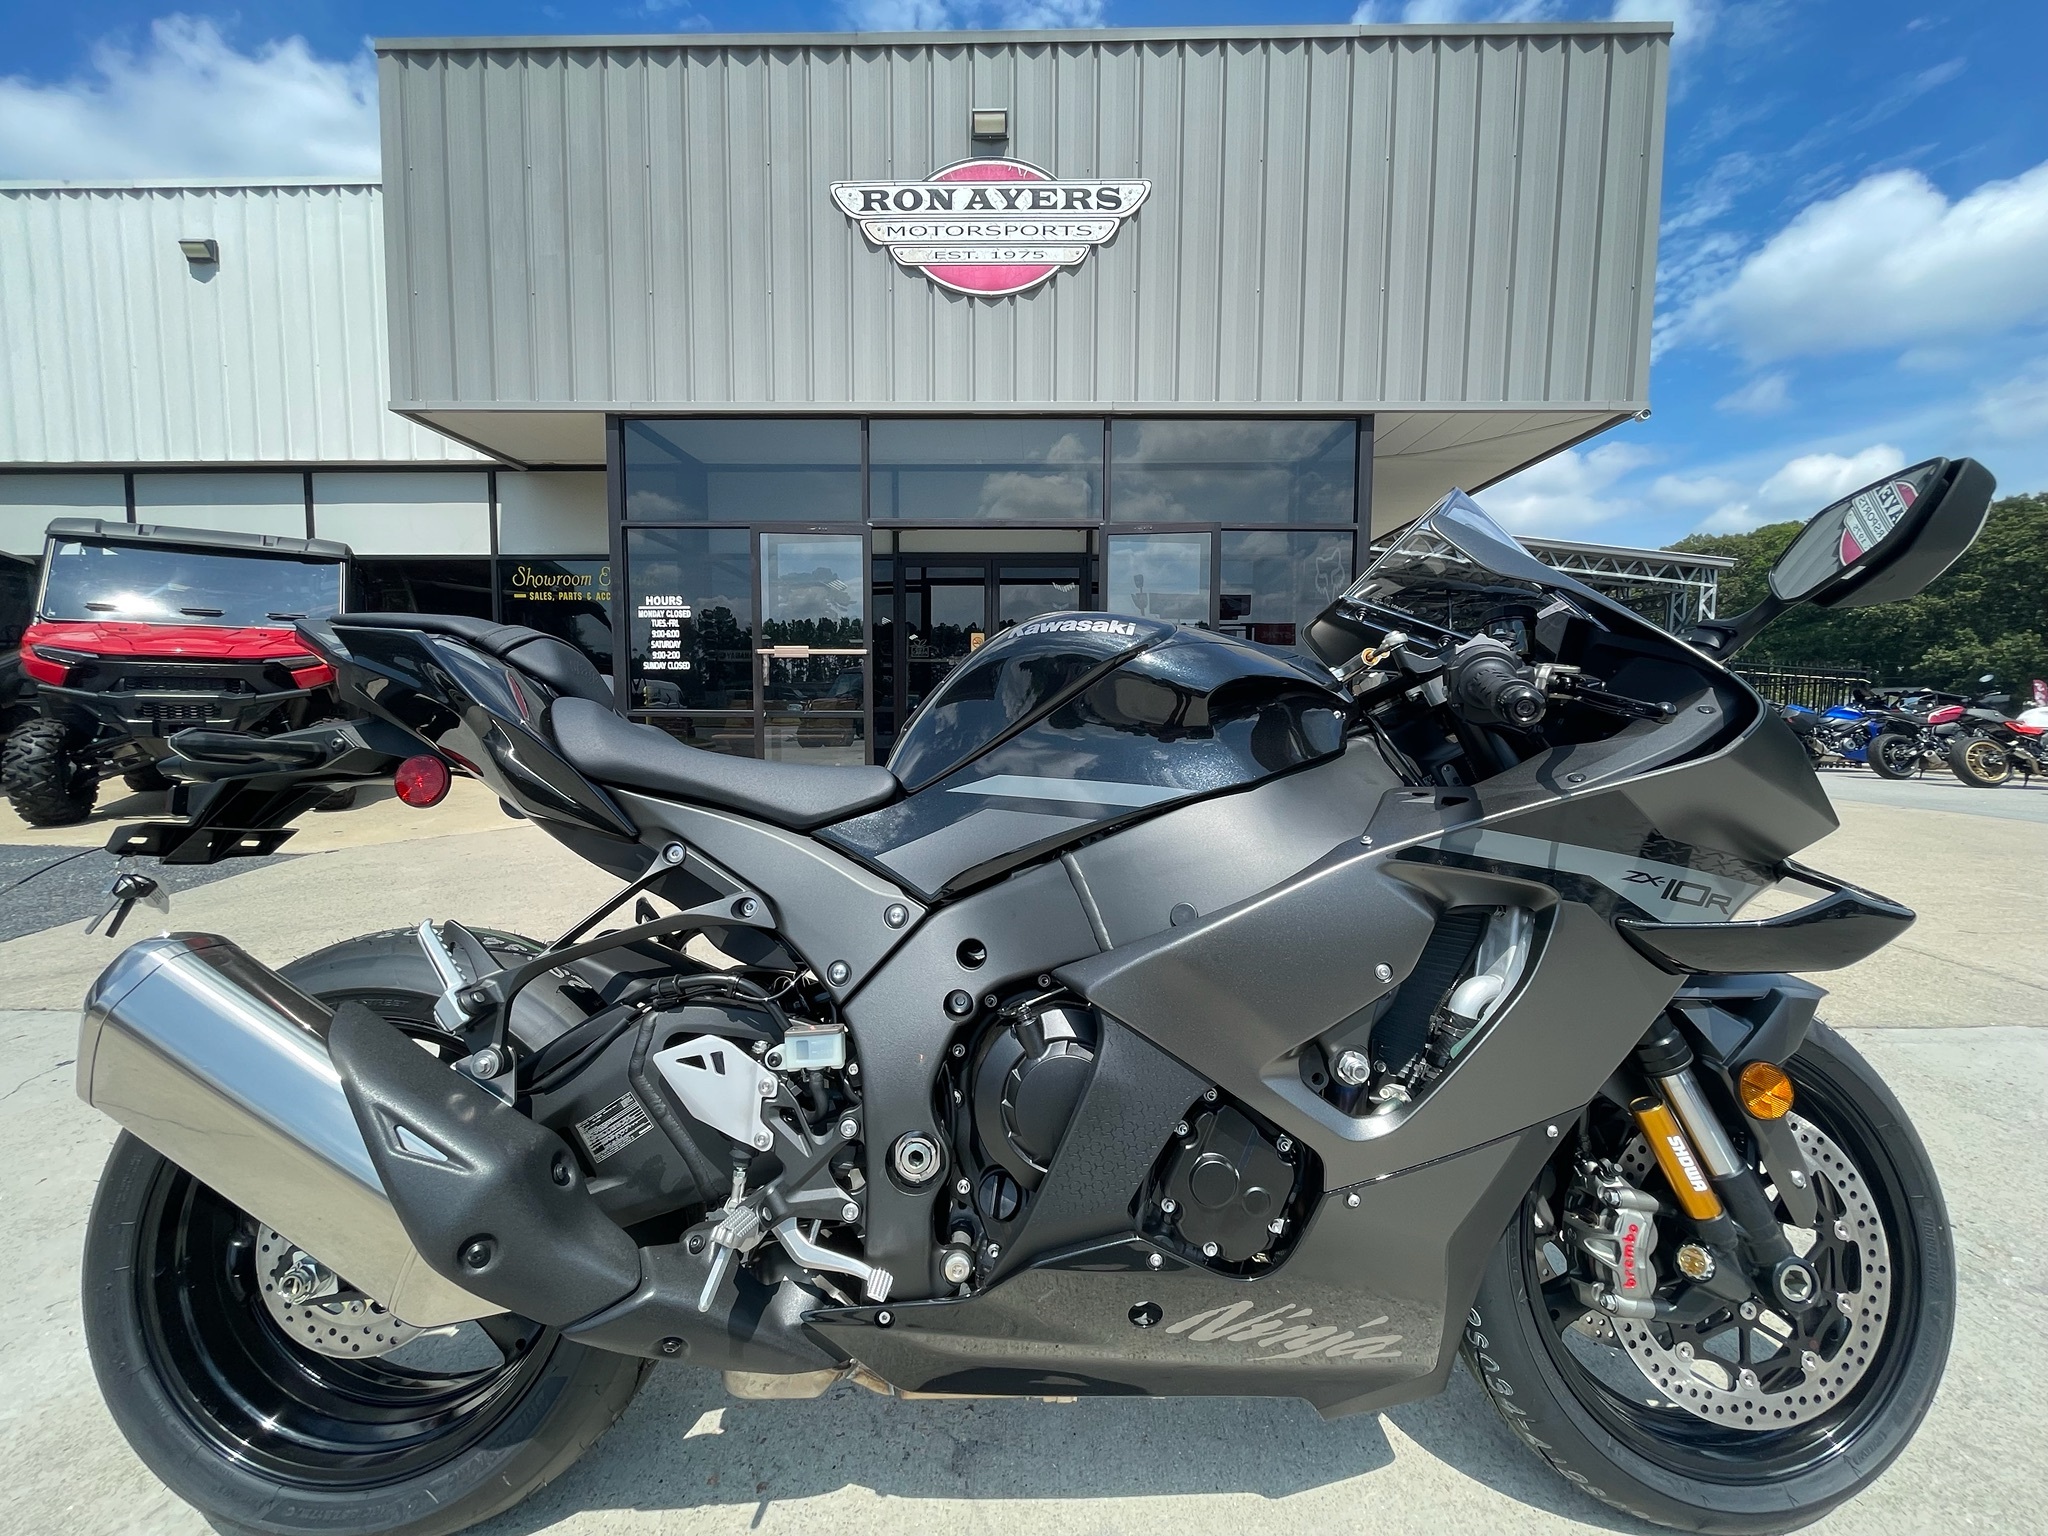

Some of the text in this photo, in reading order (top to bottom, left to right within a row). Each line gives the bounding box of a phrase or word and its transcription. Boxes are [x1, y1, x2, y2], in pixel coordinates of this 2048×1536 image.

[859, 187, 1123, 212] RON AYERS
[886, 225, 1093, 237] MOTORSPORTS
[934, 250, 1045, 260] EST. 1975
[512, 566, 592, 588] Showroom
[529, 591, 555, 602] SALES,
[558, 591, 582, 601] PARTS
[645, 595, 683, 606] HOURS
[638, 610, 691, 618] MONDAY CLOSED
[1007, 619, 1137, 638] Kawasaki
[650, 640, 681, 649] SATURDAY
[643, 661, 691, 670] SUNDAY CLOSED
[1621, 870, 1733, 915] ZX-10R
[1666, 1135, 1708, 1192] SHOWA
[1622, 1224, 1639, 1289] brembo
[1165, 1300, 1403, 1361] Ninja
